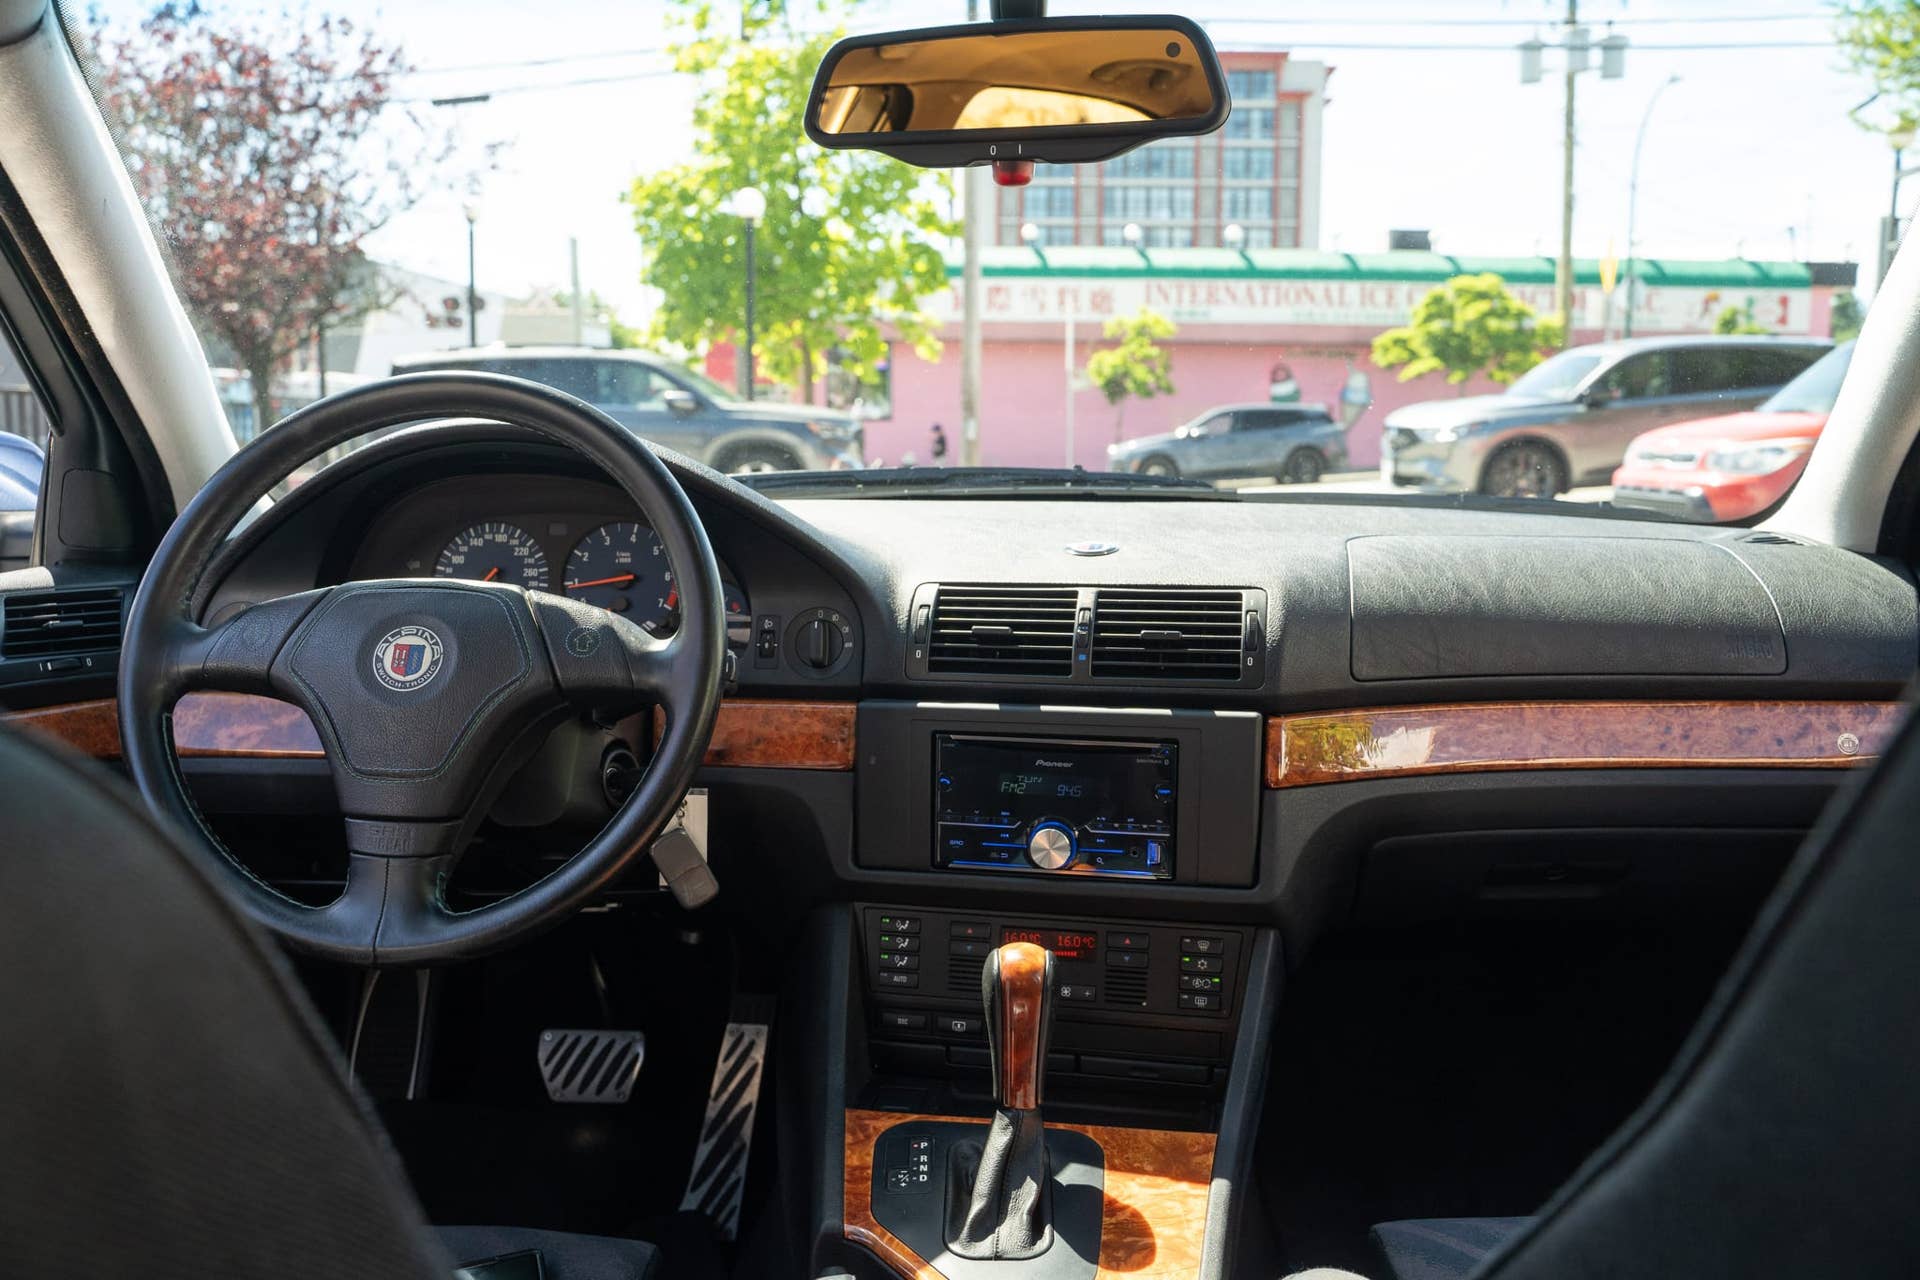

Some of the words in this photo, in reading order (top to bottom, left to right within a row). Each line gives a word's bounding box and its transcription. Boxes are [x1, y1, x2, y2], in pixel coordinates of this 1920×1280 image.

[990, 145, 997, 155] 0
[1144, 281, 1351, 308] INTERNATIONAL
[1360, 284, 1397, 309] ICE
[469, 537, 483, 547] 140
[494, 534, 508, 542] 180
[604, 535, 611, 546] 3
[630, 533, 637, 543] 4
[513, 547, 529, 556] 220
[652, 545, 660, 555] 5
[451, 555, 465, 565] 100
[582, 551, 590, 561] 2
[522, 567, 539, 577] 260
[664, 571, 671, 582] 6
[657, 598, 664, 608] 7
[377, 628, 440, 661] ALPINA
[915, 649, 922, 658] 0
[1247, 656, 1254, 666] 0
[1035, 759, 1074, 768] Pioneer
[1001, 781, 1026, 795] FM2
[893, 975, 908, 983] AUTO
[920, 1141, 928, 1149] P
[920, 1155, 928, 1163] R
[919, 1164, 928, 1172] N
[919, 1174, 928, 1182] D
